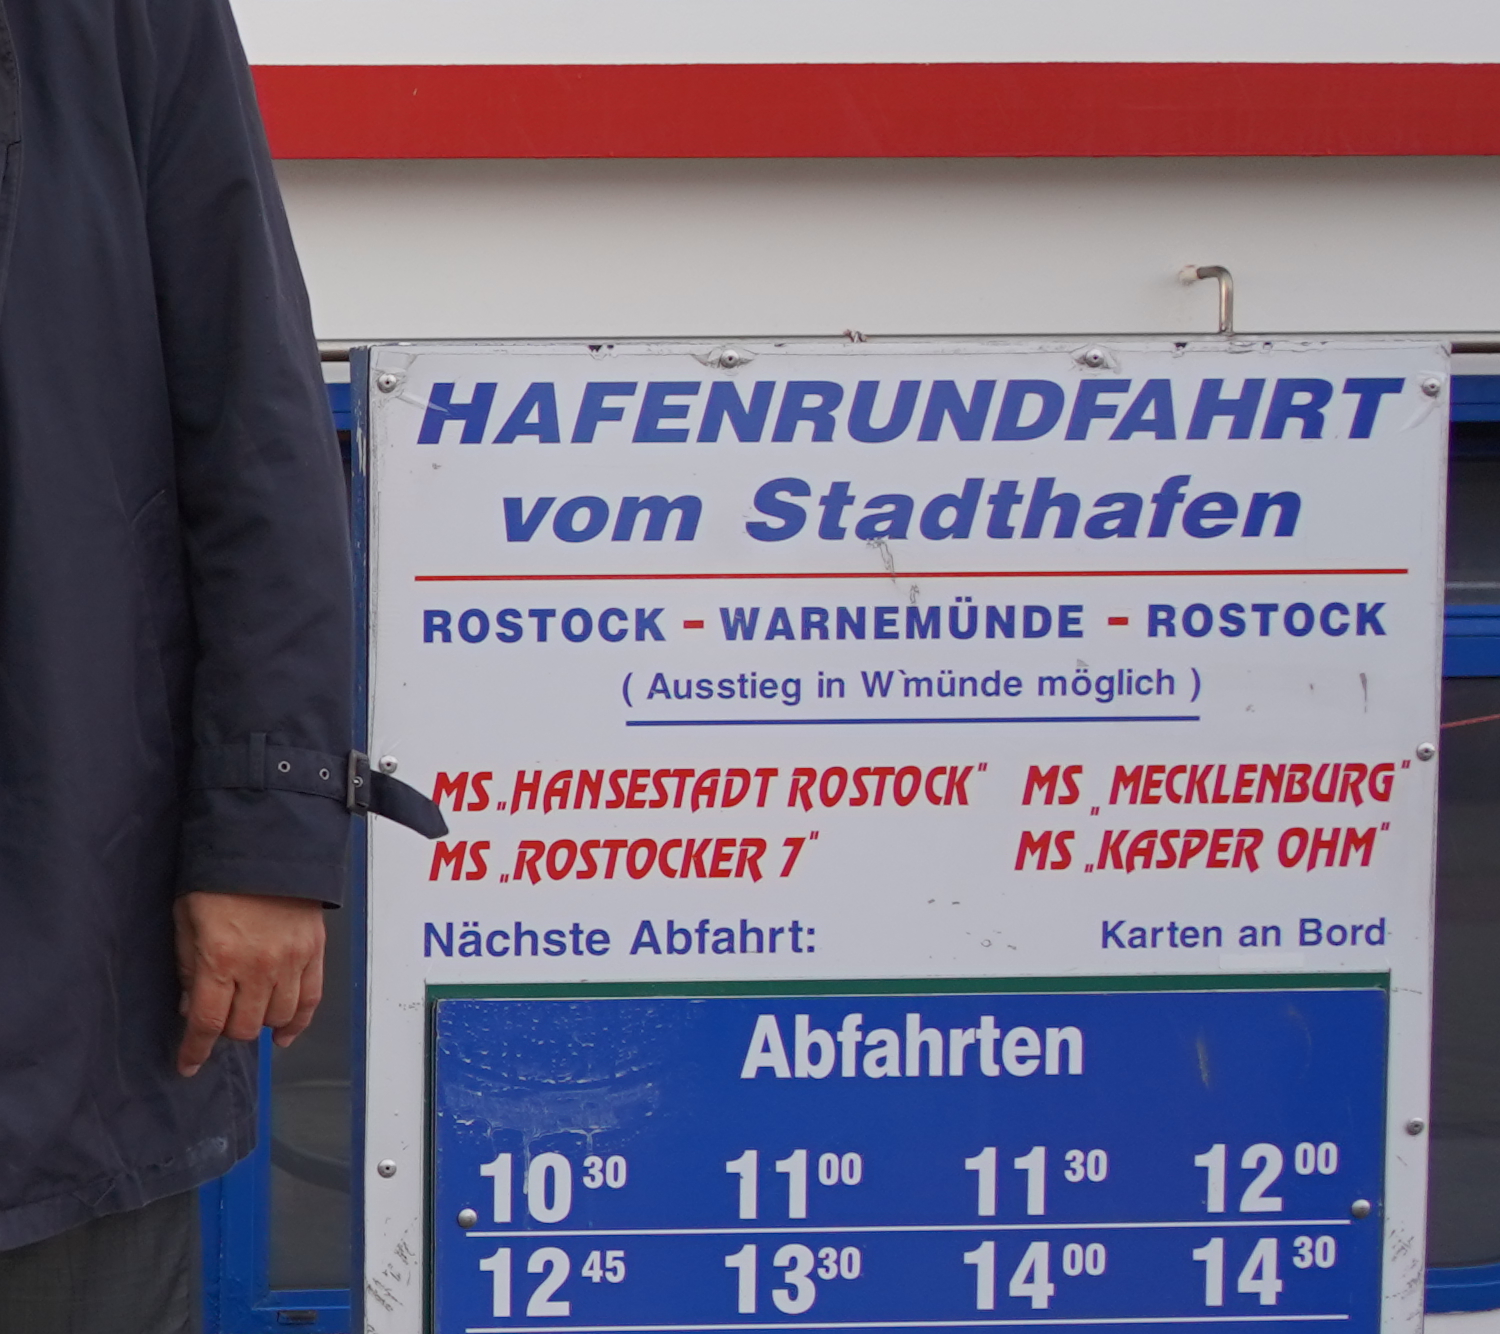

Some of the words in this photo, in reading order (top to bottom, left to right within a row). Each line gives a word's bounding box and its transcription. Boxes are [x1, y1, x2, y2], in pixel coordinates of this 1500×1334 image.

[418, 377, 1404, 444] HAFENRUNDFAHRT
[504, 495, 702, 542] vom
[746, 475, 1301, 541] Stadthafen
[424, 608, 665, 643] ROSTOCK
[720, 597, 1083, 640] WARNEMÜNDE
[1149, 602, 1386, 637] ROSTOCK
[648, 673, 801, 706] Ausstieg
[818, 672, 845, 697] in
[1039, 669, 1175, 702] möglich
[432, 772, 493, 811] MS
[1023, 765, 1083, 805] MS
[429, 841, 490, 881] MS
[1015, 831, 1075, 870] MS
[425, 922, 610, 957] Nächste
[630, 919, 815, 954] Abfahrt:
[1102, 921, 1222, 948] Karten
[1239, 925, 1281, 946] an
[1300, 917, 1386, 946] Bord
[741, 1014, 1082, 1078] Abfahrten
[480, 1153, 571, 1223] 10
[727, 1150, 806, 1219] 11
[966, 1147, 1045, 1215] 11
[1195, 1144, 1282, 1212] 12
[480, 1248, 569, 1317] 12
[726, 1244, 815, 1314] 13
[964, 1242, 1054, 1309] 14
[1193, 1238, 1282, 1306] 14
